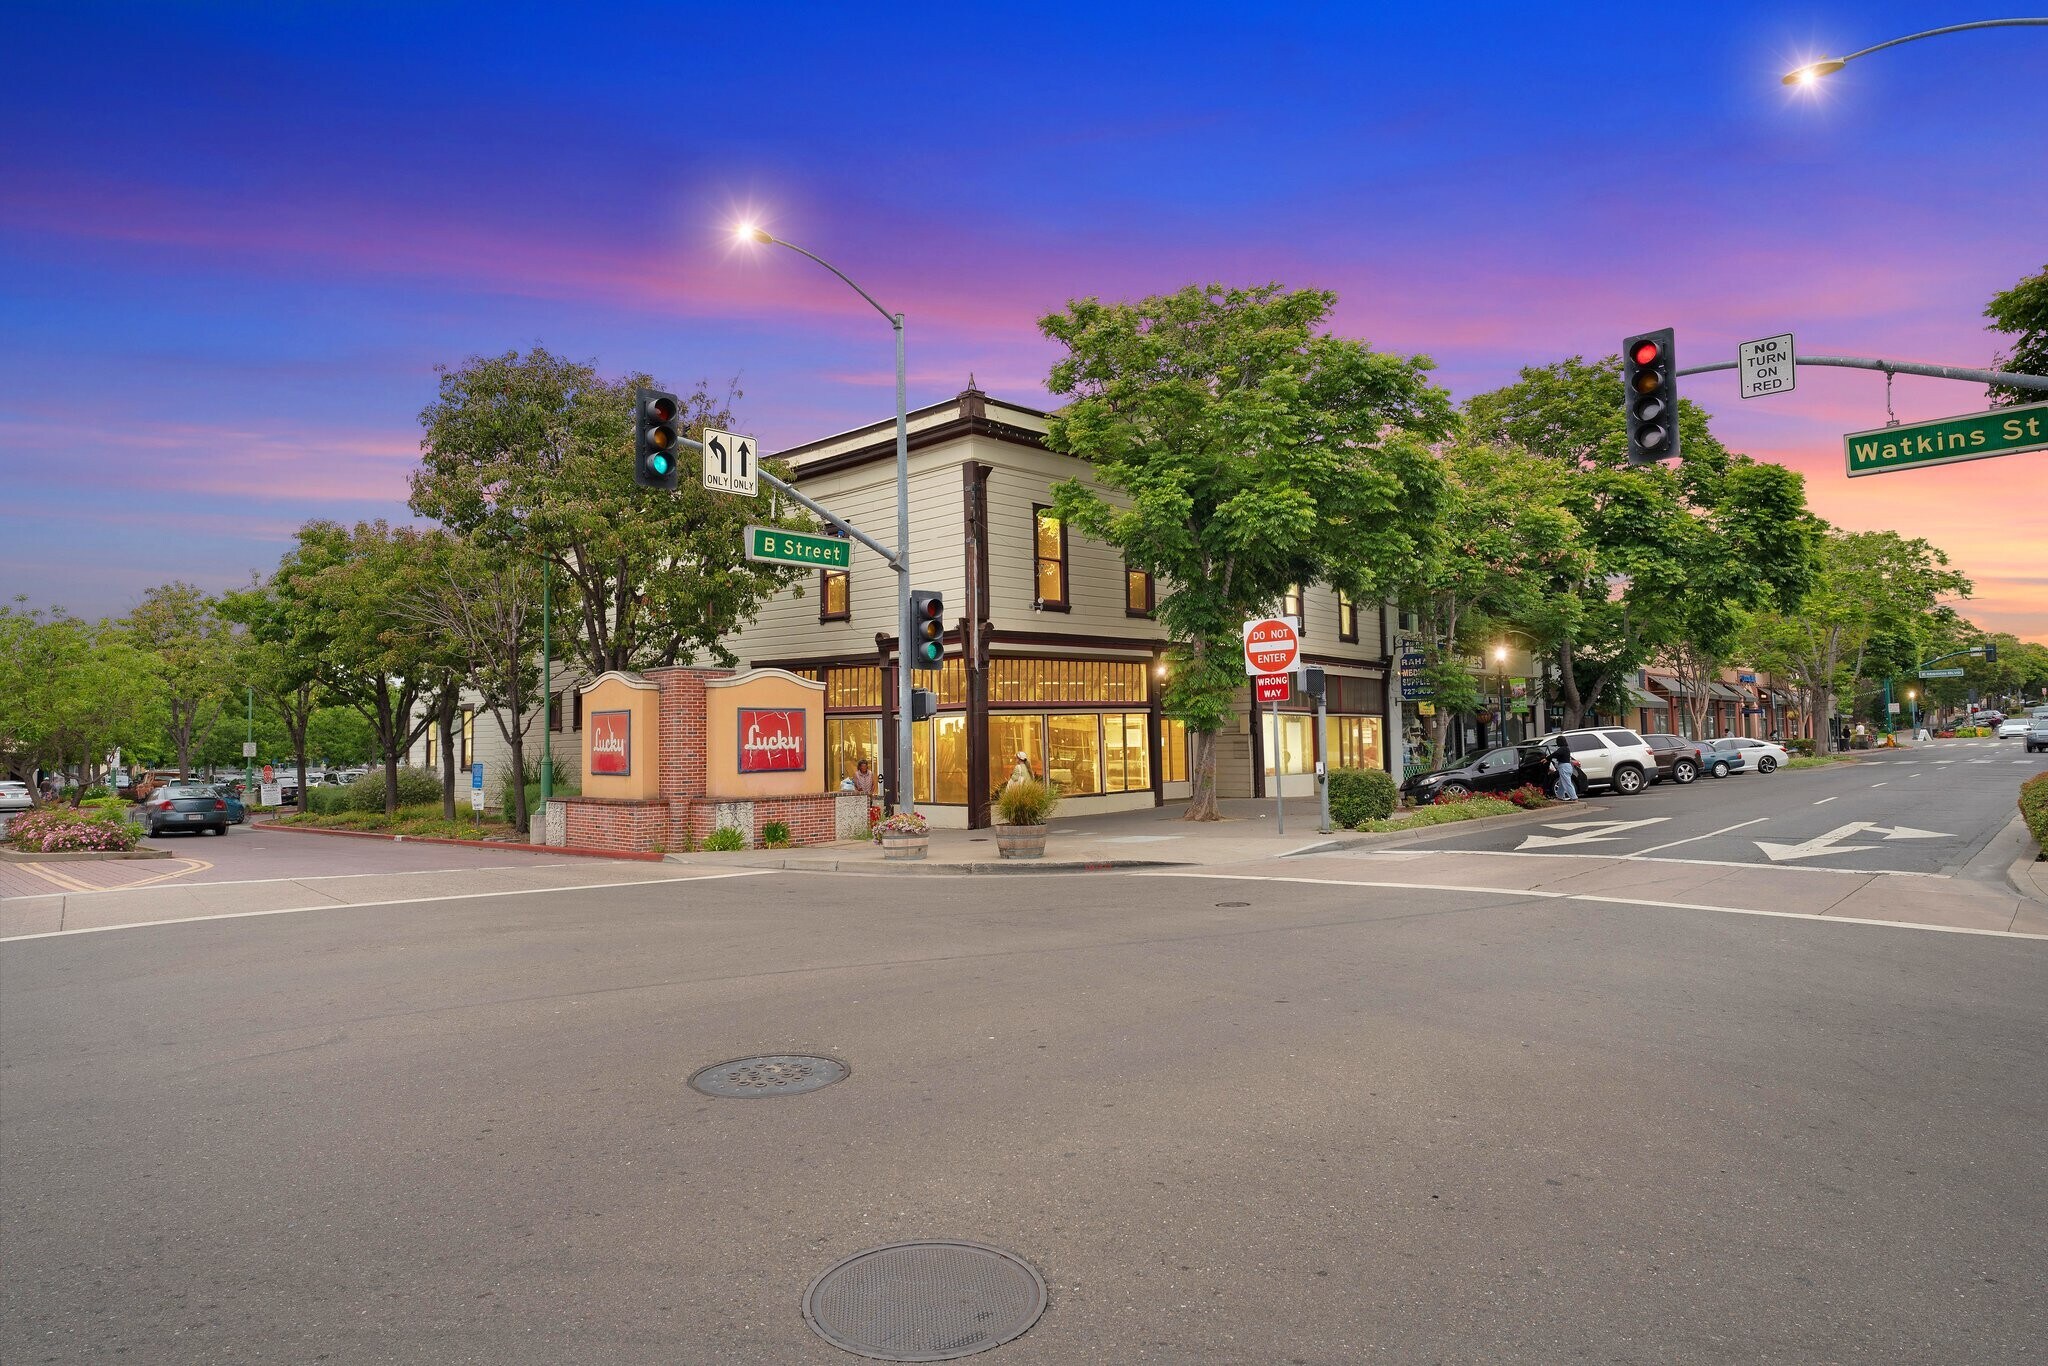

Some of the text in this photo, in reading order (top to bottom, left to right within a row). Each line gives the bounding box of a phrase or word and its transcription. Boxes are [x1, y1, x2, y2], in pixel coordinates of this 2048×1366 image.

[1754, 341, 1778, 354] NO
[1747, 351, 1786, 367] TURN
[1757, 366, 1778, 378] ON
[1753, 378, 1782, 392] RED
[1855, 417, 2040, 463] Watkins St
[707, 474, 729, 487] ONLY
[733, 478, 754, 491] ONLY
[764, 537, 840, 561] B Street
[1253, 629, 1288, 640] DO NOT
[1257, 653, 1286, 663] ENTER
[1257, 676, 1288, 687] WRONG
[1263, 689, 1282, 698] WAY
[593, 727, 625, 757] Lucky
[744, 724, 801, 753] Lucky
